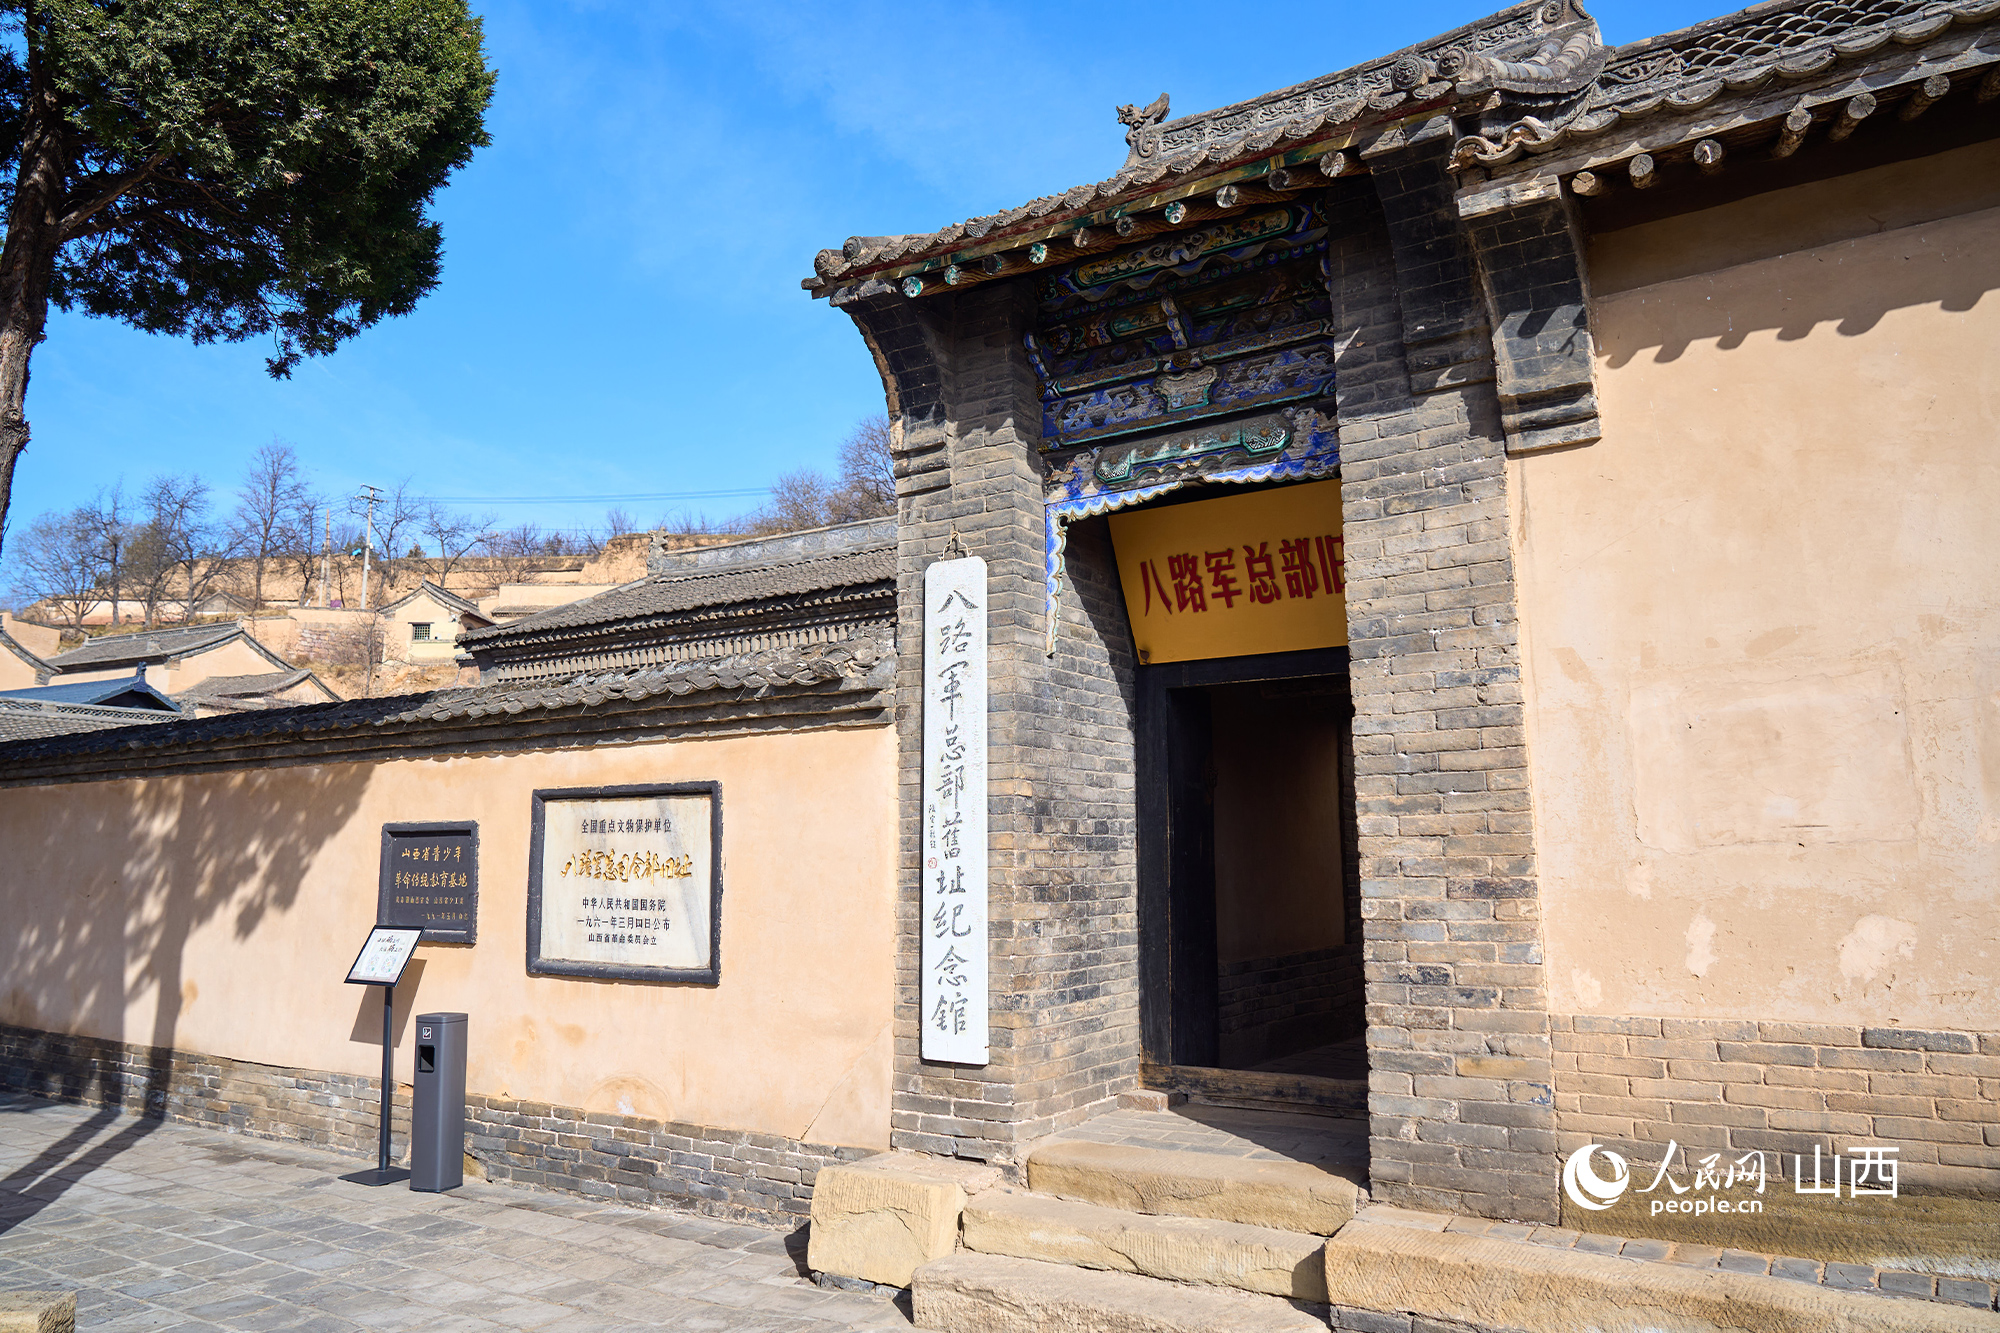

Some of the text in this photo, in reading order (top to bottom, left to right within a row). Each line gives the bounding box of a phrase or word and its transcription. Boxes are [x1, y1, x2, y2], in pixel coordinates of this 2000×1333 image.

[1140, 533, 1345, 617] 八路军总部旧
[581, 818, 672, 834] 全国重点文物保护单位
[401, 844, 462, 863] 山西省青少年
[394, 870, 468, 889] 革命传统教育基地
[582, 896, 667, 912] 中华人民共和国国务院
[577, 915, 671, 931] 一九六一年三月四日公布
[588, 933, 657, 946] 山西省革命委员会立
